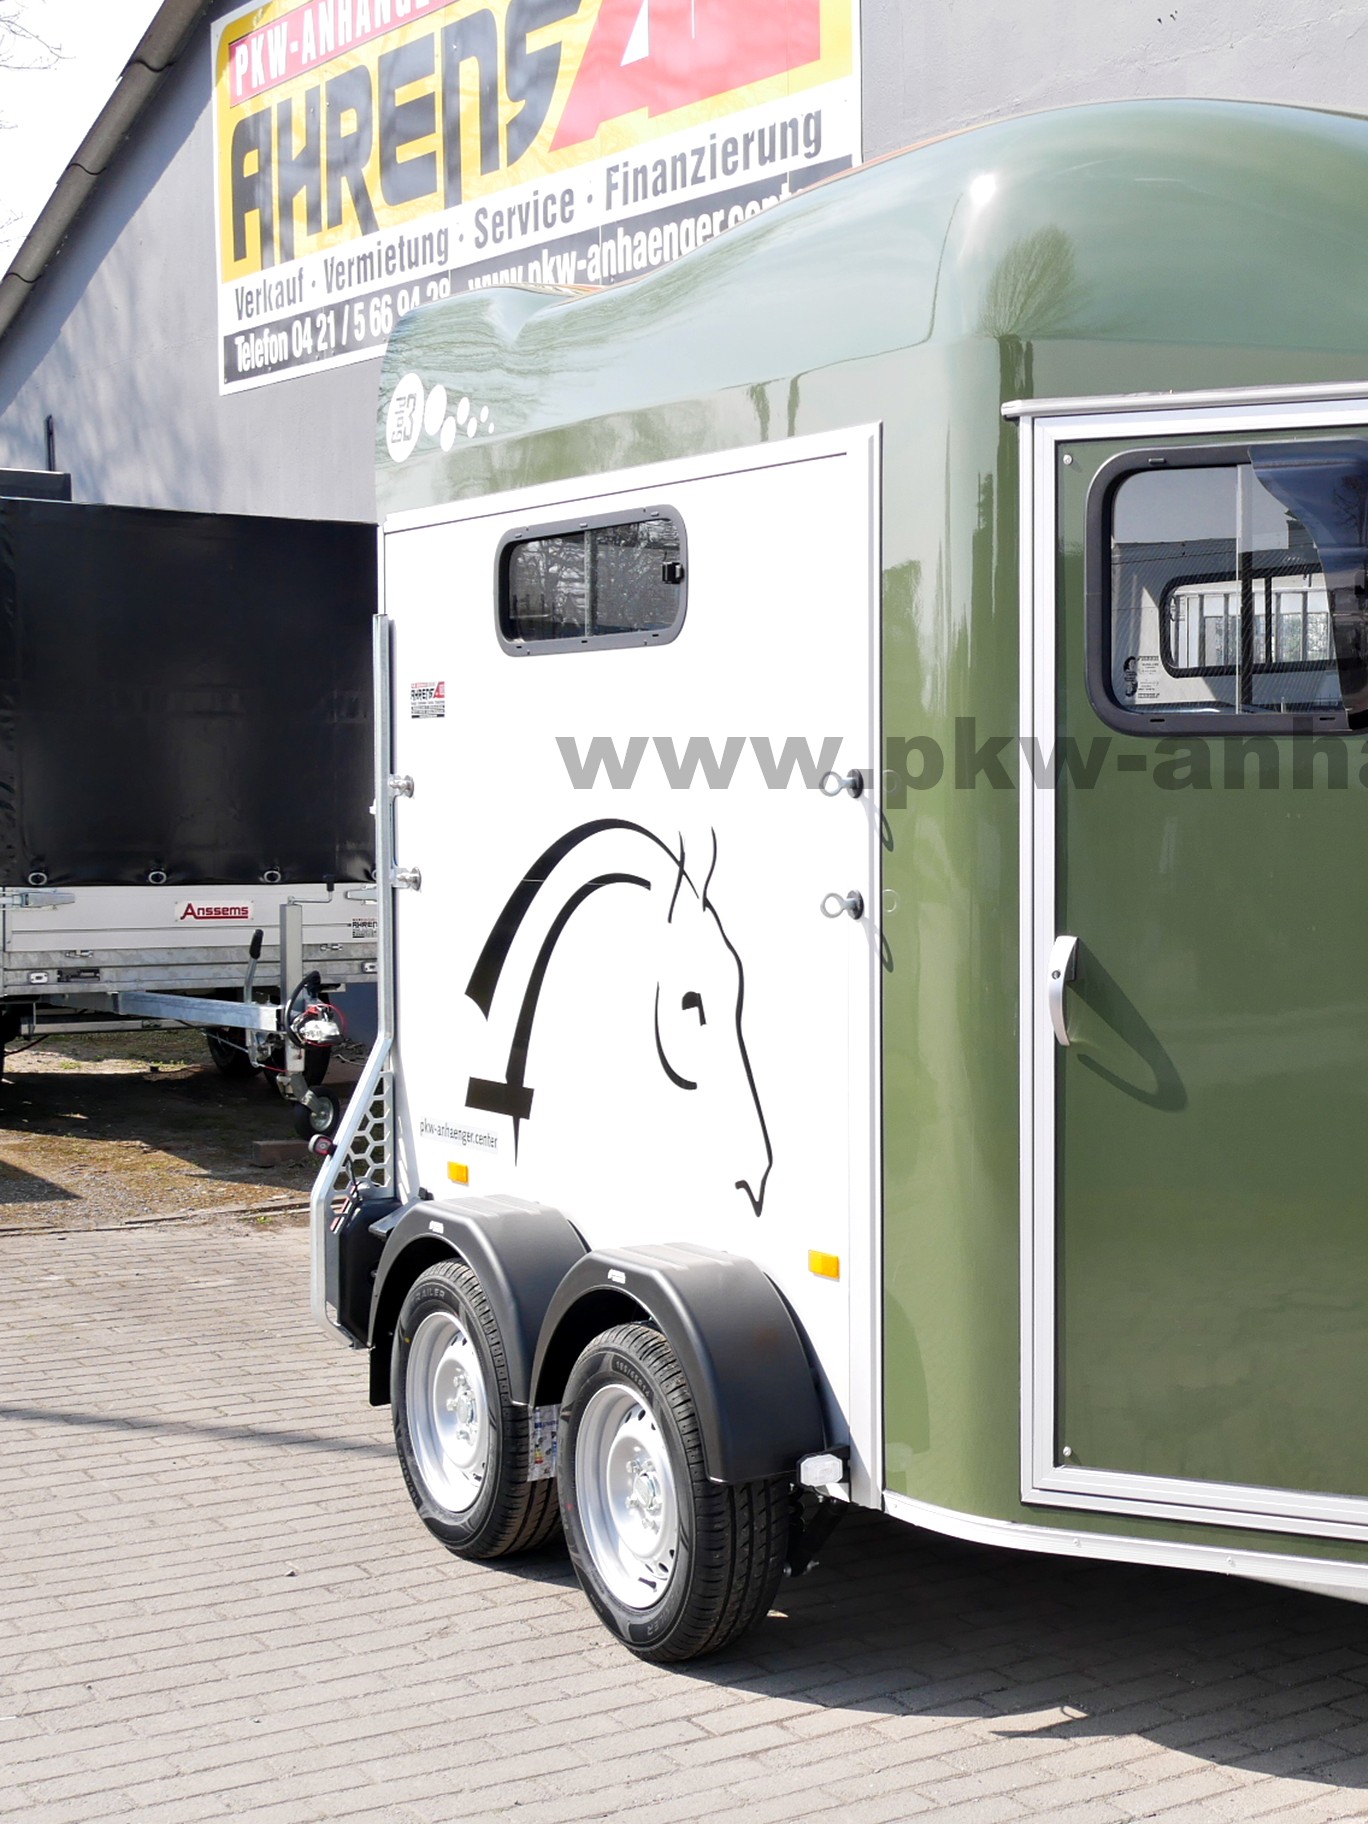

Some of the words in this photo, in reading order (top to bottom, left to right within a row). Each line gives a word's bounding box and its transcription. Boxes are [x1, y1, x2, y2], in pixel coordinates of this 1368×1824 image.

[235, 267, 304, 321] Verkauf
[323, 227, 449, 294] Vermietung
[474, 188, 575, 249] Service
[606, 109, 822, 211] Finanzierung
[234, 328, 289, 373] Telefon
[291, 316, 314, 358] 04
[316, 310, 336, 352] 21
[353, 300, 366, 342] 5
[369, 293, 394, 337] 66
[180, 902, 249, 920] Anssems
